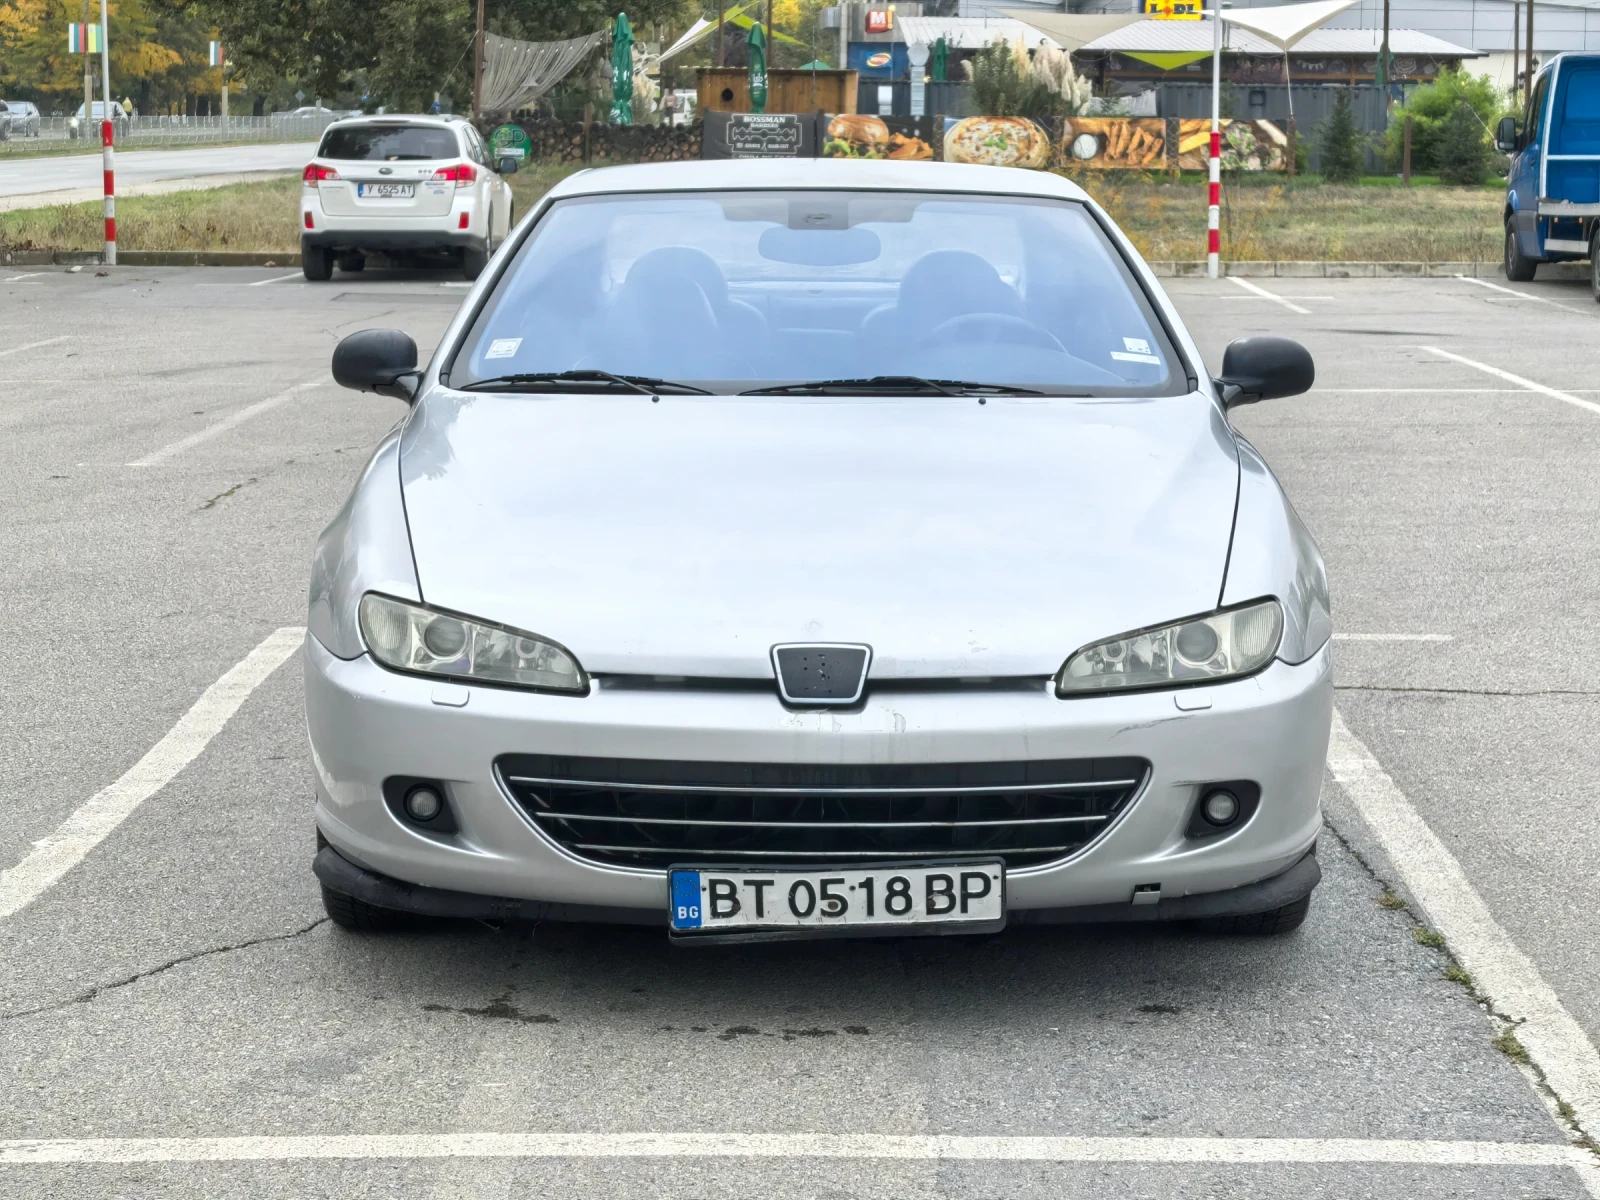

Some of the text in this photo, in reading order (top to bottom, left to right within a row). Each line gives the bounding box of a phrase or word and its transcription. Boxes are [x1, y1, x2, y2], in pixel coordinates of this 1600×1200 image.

[743, 115, 786, 123] BOSSMAN
[377, 184, 399, 194] 6525
[401, 184, 413, 194] AT
[708, 871, 992, 919] BT 0518 BP
[677, 906, 699, 919] BG
